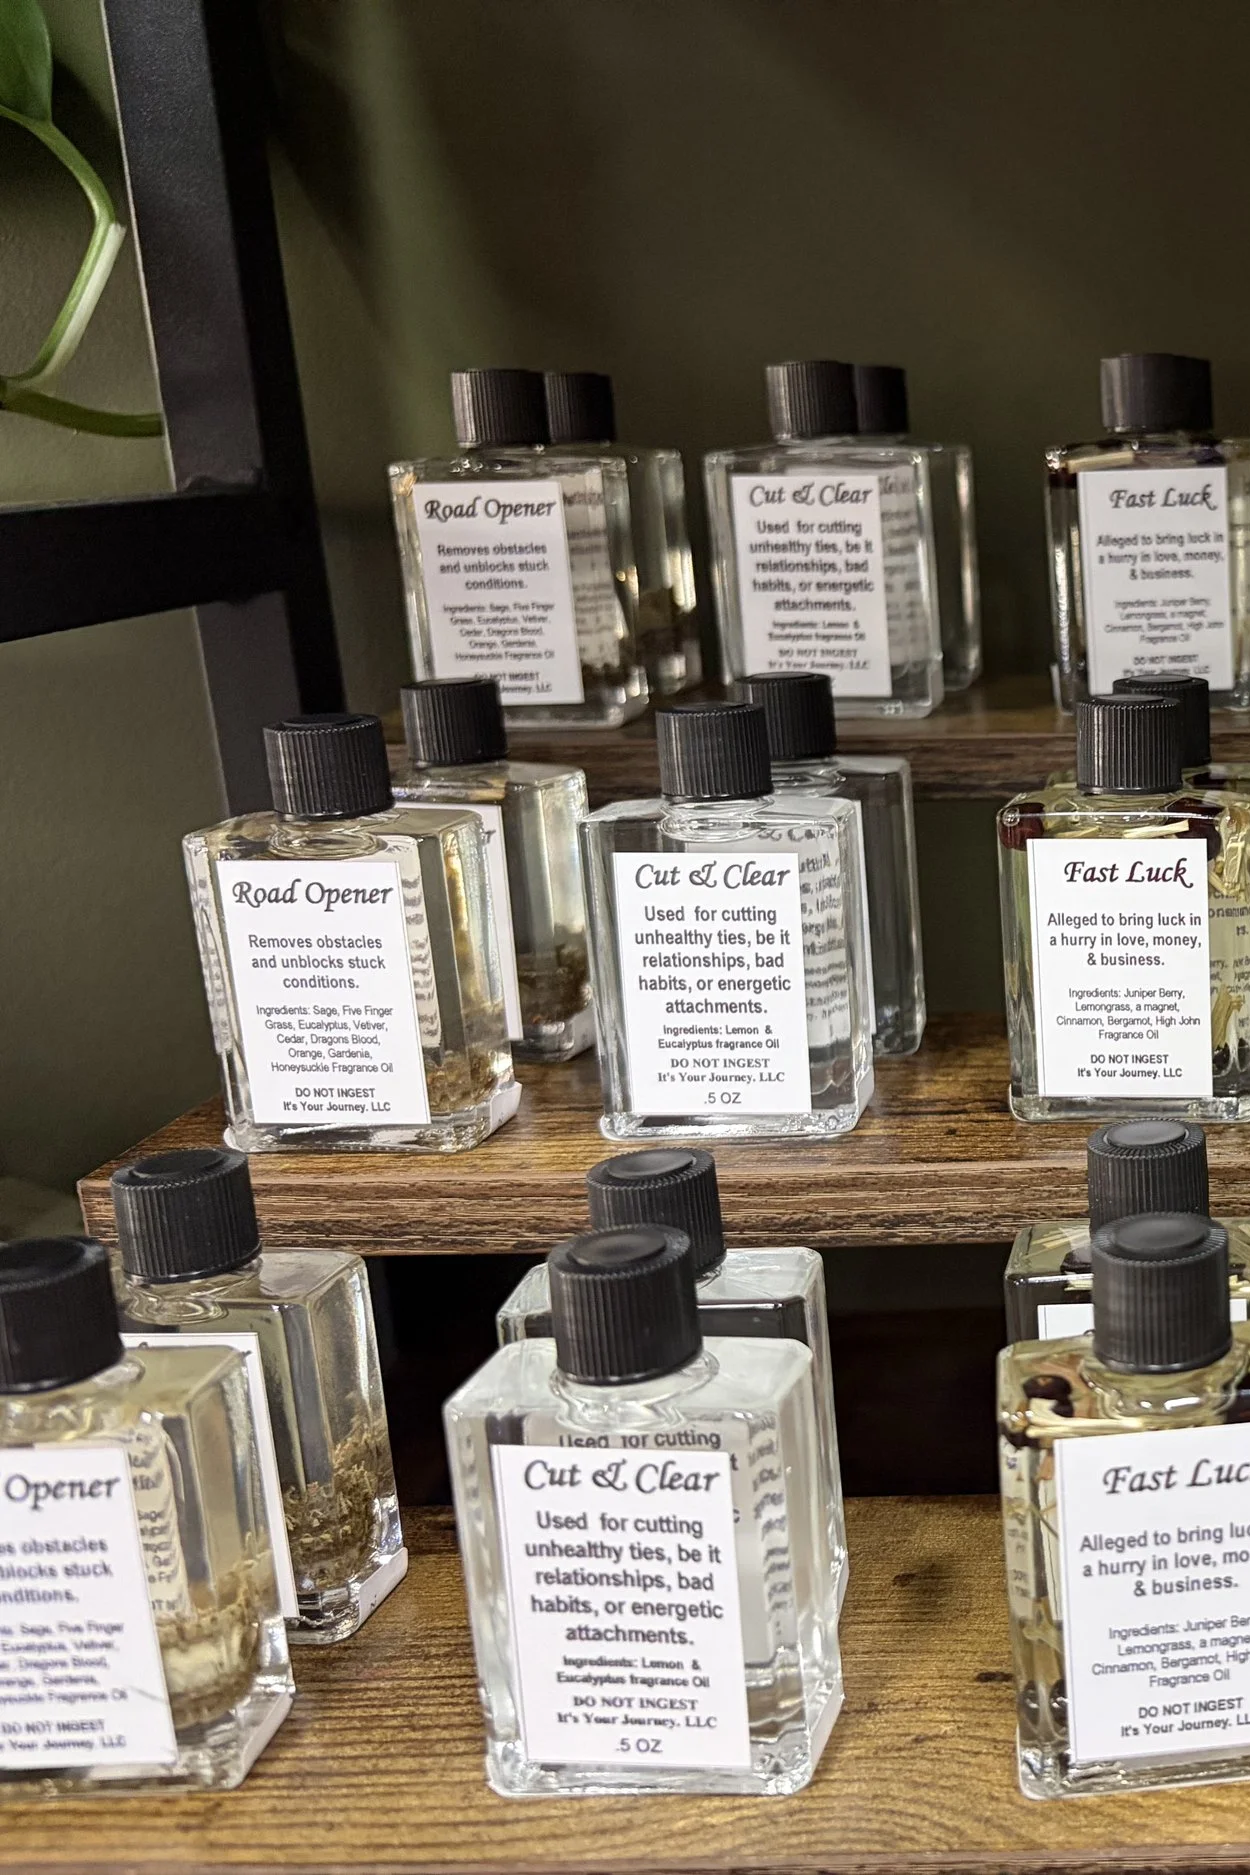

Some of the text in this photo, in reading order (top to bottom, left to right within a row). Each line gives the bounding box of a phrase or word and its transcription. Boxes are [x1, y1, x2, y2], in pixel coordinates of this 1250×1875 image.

[748, 481, 872, 507] Cut & Clear
[1109, 483, 1218, 511] Fast Luck
[424, 495, 556, 525] Road Opener
[756, 520, 862, 537] Used for cutting
[635, 860, 791, 889] Cut & Clear
[1064, 857, 1193, 888] Fast Luck
[232, 878, 393, 912] Road Opener
[1047, 912, 1201, 929] Alleged to bring luck in
[248, 934, 382, 949] Removes obstacles
[251, 954, 386, 969] and unblocks stuck
[282, 974, 359, 988] conditions.
[256, 1004, 393, 1018] Ingredients: Sage, Five Finger
[663, 1024, 773, 1037] Ingredients: Lemon &
[1098, 1029, 1159, 1041] Fragrance Oil
[658, 1038, 779, 1051] Eucalyptus fragrance Oil
[295, 1087, 375, 1098] DO NOT INGEST
[704, 1092, 741, 1104] .5 OZ
[523, 1458, 720, 1494] Cut & Clear
[1102, 1465, 1177, 1495] Fast
[5, 1474, 120, 1511] Opener
[536, 1510, 703, 1539] Used for cutting
[1133, 1575, 1238, 1597] & business.
[1138, 1696, 1244, 1719] DO NOT INGEST
